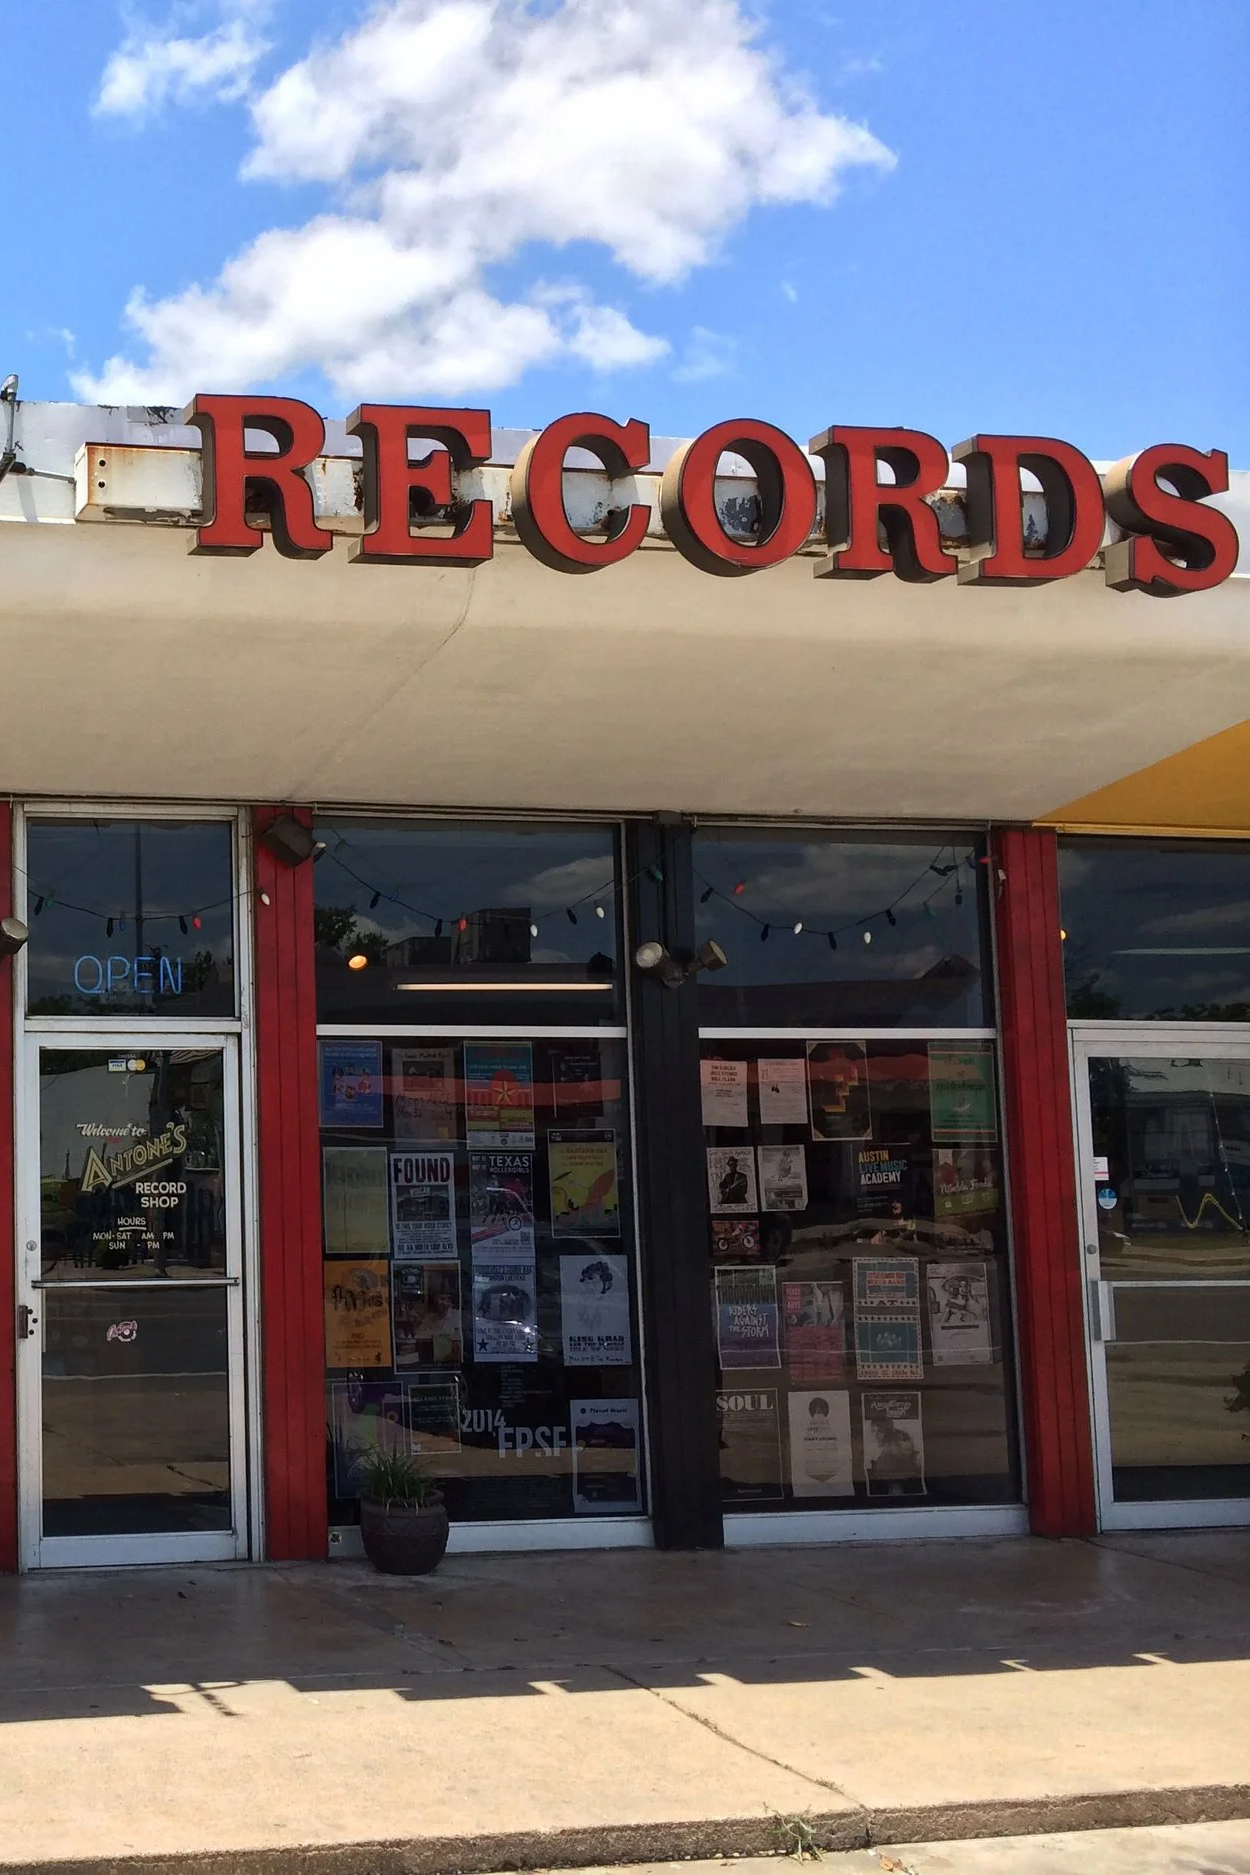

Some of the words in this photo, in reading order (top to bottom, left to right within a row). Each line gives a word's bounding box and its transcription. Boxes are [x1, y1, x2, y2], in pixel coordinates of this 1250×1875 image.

[187, 393, 1240, 598] RECORDS
[74, 954, 183, 995] OPEN
[76, 1122, 130, 1137] Welcome
[81, 1121, 188, 1192] ANTONE'S
[488, 1155, 530, 1167] TEXAS
[858, 1149, 890, 1163] AUSTIN
[393, 1157, 451, 1184] FOUND
[859, 1162, 880, 1173] LIVE
[880, 1159, 908, 1172] MUSIC
[860, 1171, 901, 1185] ACADEMY
[135, 1181, 187, 1195] RECORD
[140, 1195, 180, 1208] SHOP
[117, 1216, 147, 1226] HOURS
[141, 1231, 155, 1240] AM
[162, 1231, 175, 1240] PM
[108, 1240, 126, 1250] SUN
[147, 1240, 160, 1250] PM
[729, 1304, 758, 1316] RIDERS
[734, 1313, 769, 1326] AGAINST
[741, 1324, 770, 1338] STORM
[715, 1394, 774, 1412] SOUL
[461, 1408, 506, 1433] 2014
[498, 1425, 567, 1458] FPSF
